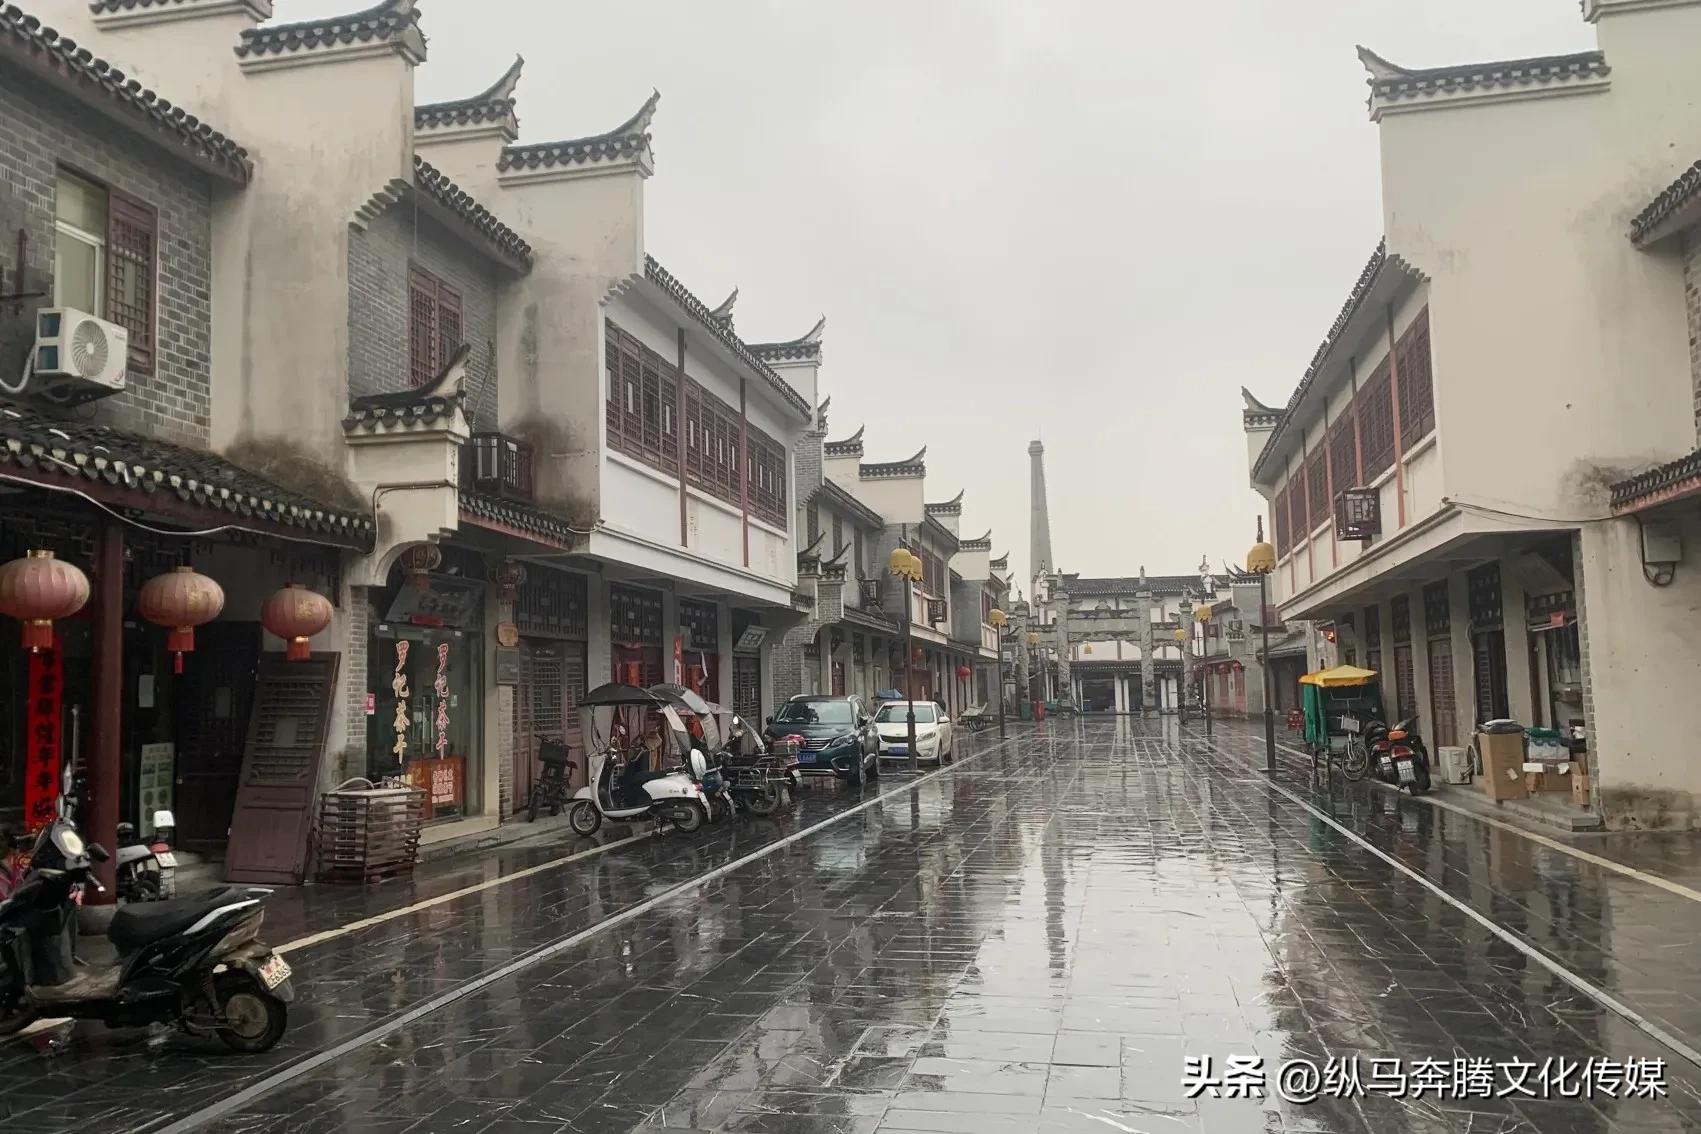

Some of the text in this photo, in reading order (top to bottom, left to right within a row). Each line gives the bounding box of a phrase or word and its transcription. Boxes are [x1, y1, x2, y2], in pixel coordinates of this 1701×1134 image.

[392, 640, 410, 764] 罗记茶干
[435, 643, 450, 760] 罗记茶干
